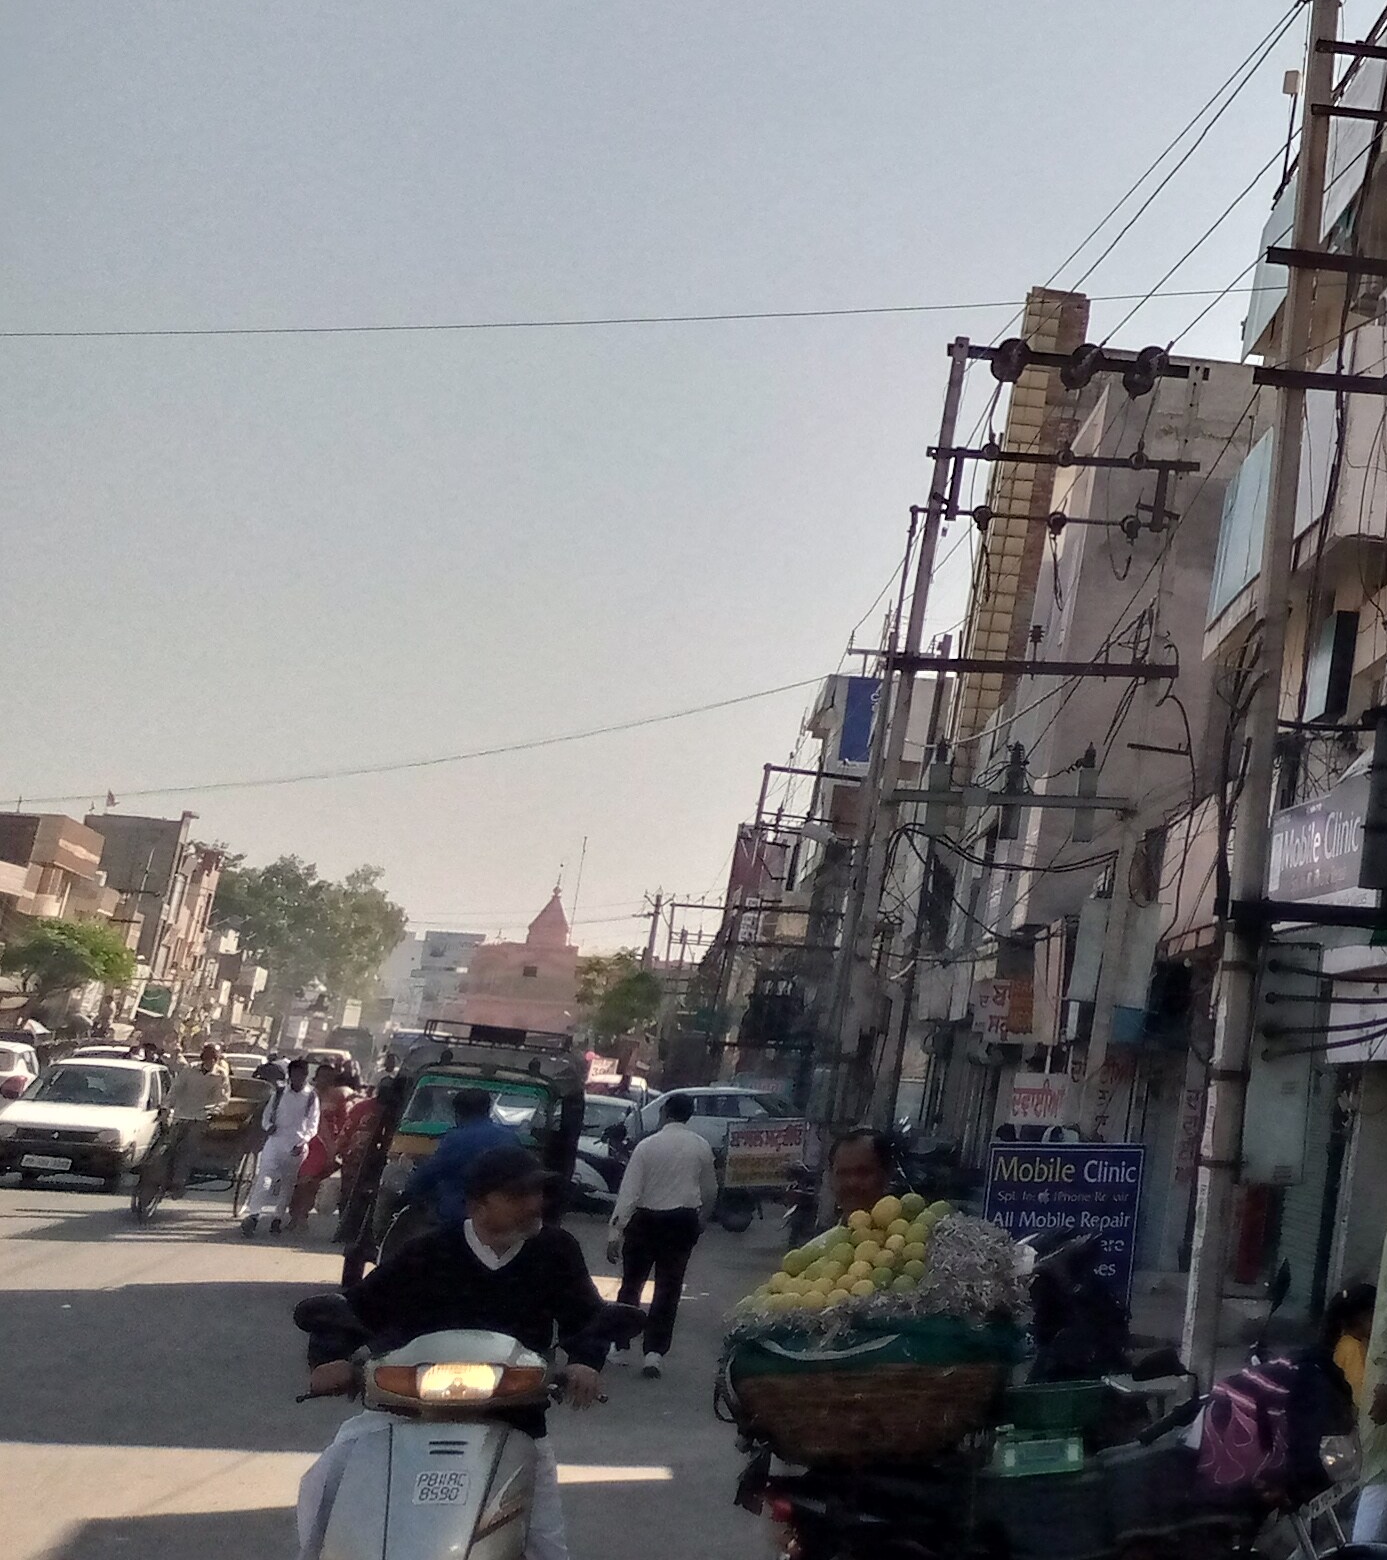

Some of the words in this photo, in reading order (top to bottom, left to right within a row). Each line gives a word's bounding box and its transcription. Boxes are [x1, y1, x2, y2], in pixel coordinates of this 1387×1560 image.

[1281, 821, 1322, 872] Mobile
[1324, 811, 1361, 860] Clinic
[993, 1156, 1076, 1183] Mobile
[1083, 1158, 1137, 1183] Clinic
[992, 1210, 1014, 1228] All
[1018, 1210, 1076, 1229] Mobile
[1080, 1211, 1131, 1232] Repair
